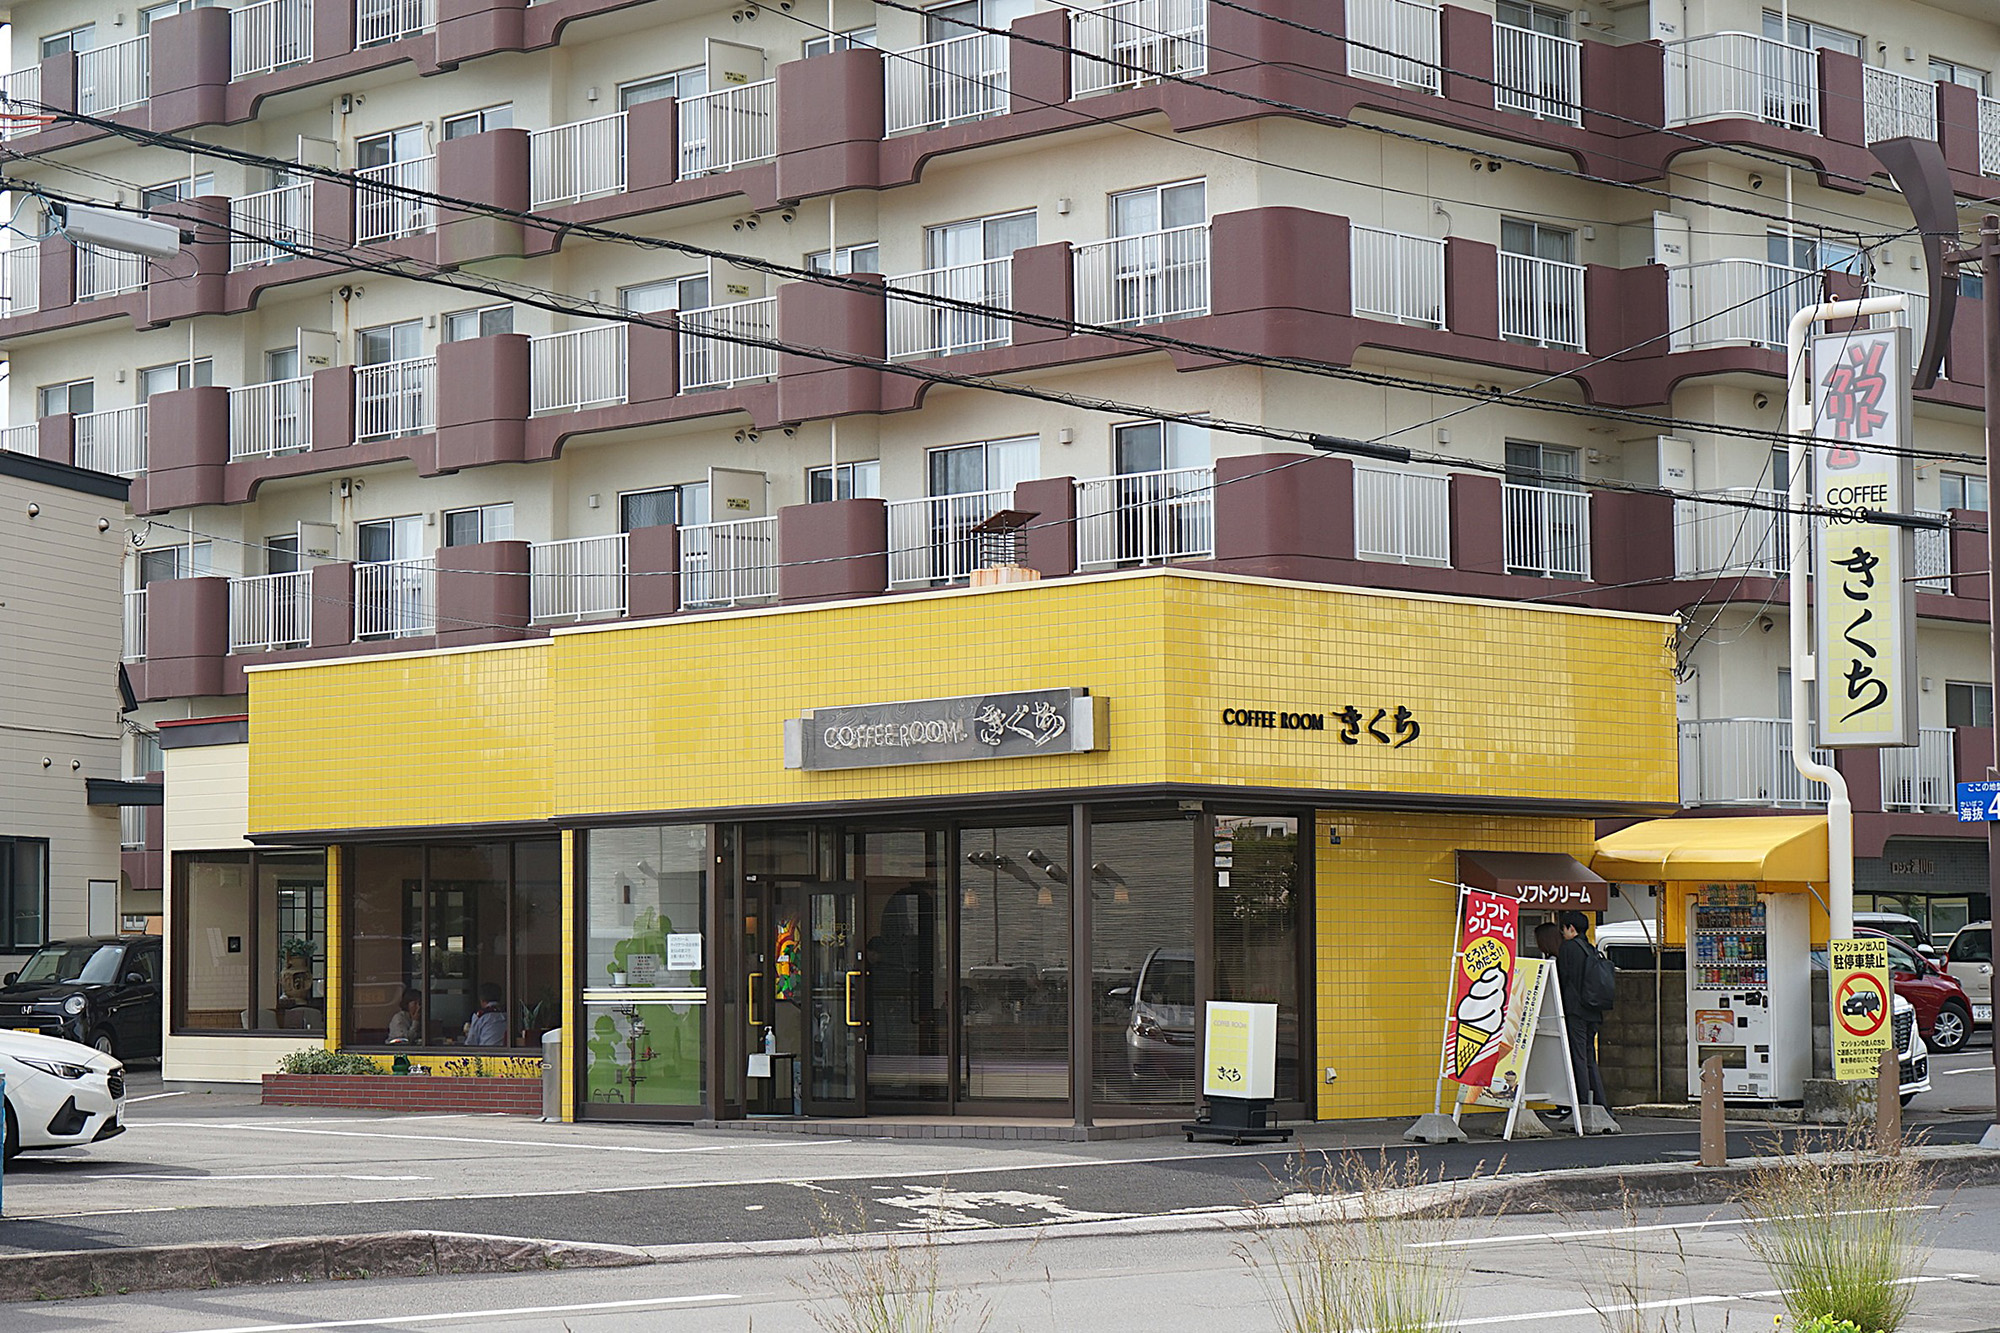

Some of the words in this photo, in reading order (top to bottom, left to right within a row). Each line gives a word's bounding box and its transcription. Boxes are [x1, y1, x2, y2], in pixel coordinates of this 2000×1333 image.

[1847, 340, 1890, 439] ソフト
[1821, 364, 1861, 470] クリーム
[1827, 484, 1888, 506] COFFEE
[1830, 546, 1889, 723] きくち
[824, 724, 900, 749] COFFEE
[900, 720, 958, 747] ROOM
[1223, 708, 1277, 729] COFFEE
[1280, 712, 1324, 730] ROOM
[1332, 705, 1420, 749] きくち
[1960, 807, 1984, 821] 海抜
[1516, 884, 1592, 904] ソフトクリーム
[1475, 900, 1510, 920] ソフト
[1468, 916, 1515, 940] クリーム
[1465, 940, 1495, 962] とろける
[1833, 941, 1885, 951] マンション出入口
[1833, 953, 1886, 970] 駐停車禁止
[1216, 1066, 1242, 1082] きくち
